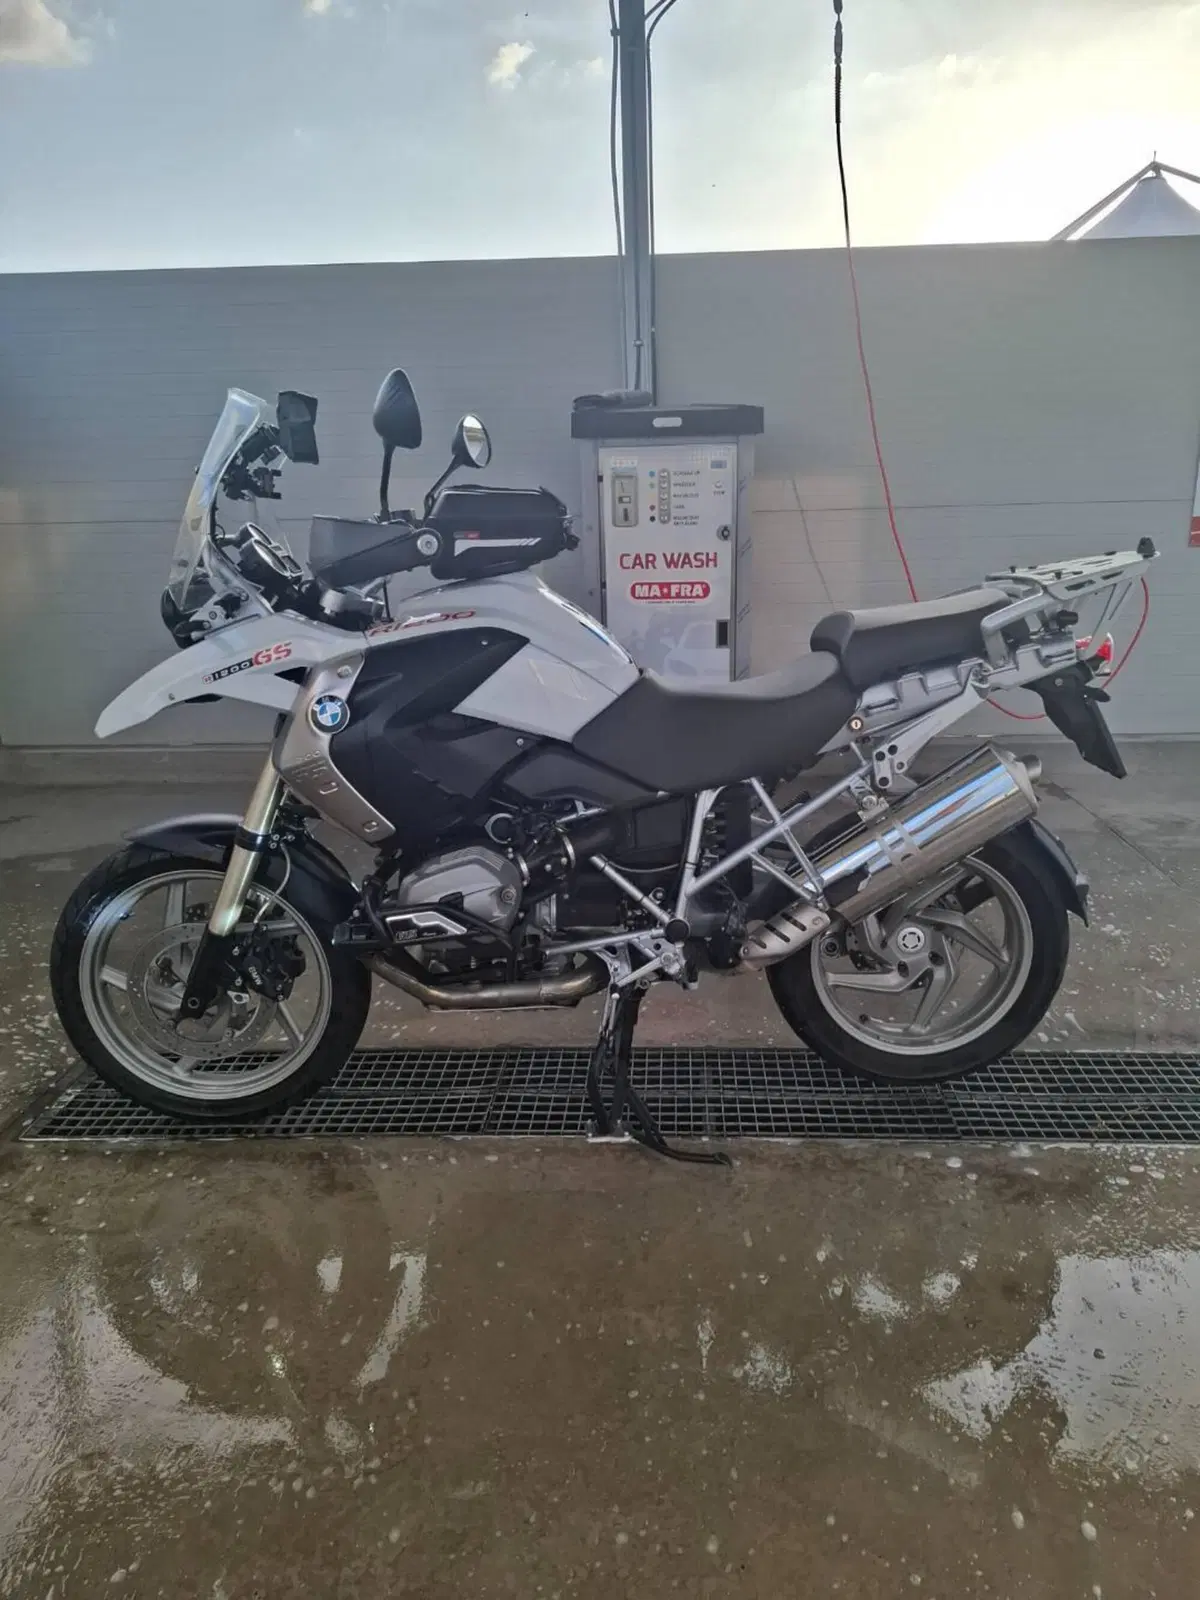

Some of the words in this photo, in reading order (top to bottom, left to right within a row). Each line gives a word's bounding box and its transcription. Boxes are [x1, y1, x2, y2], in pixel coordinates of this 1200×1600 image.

[619, 553, 657, 570] CAR
[662, 552, 718, 569] WASH
[253, 642, 292, 667] GS
